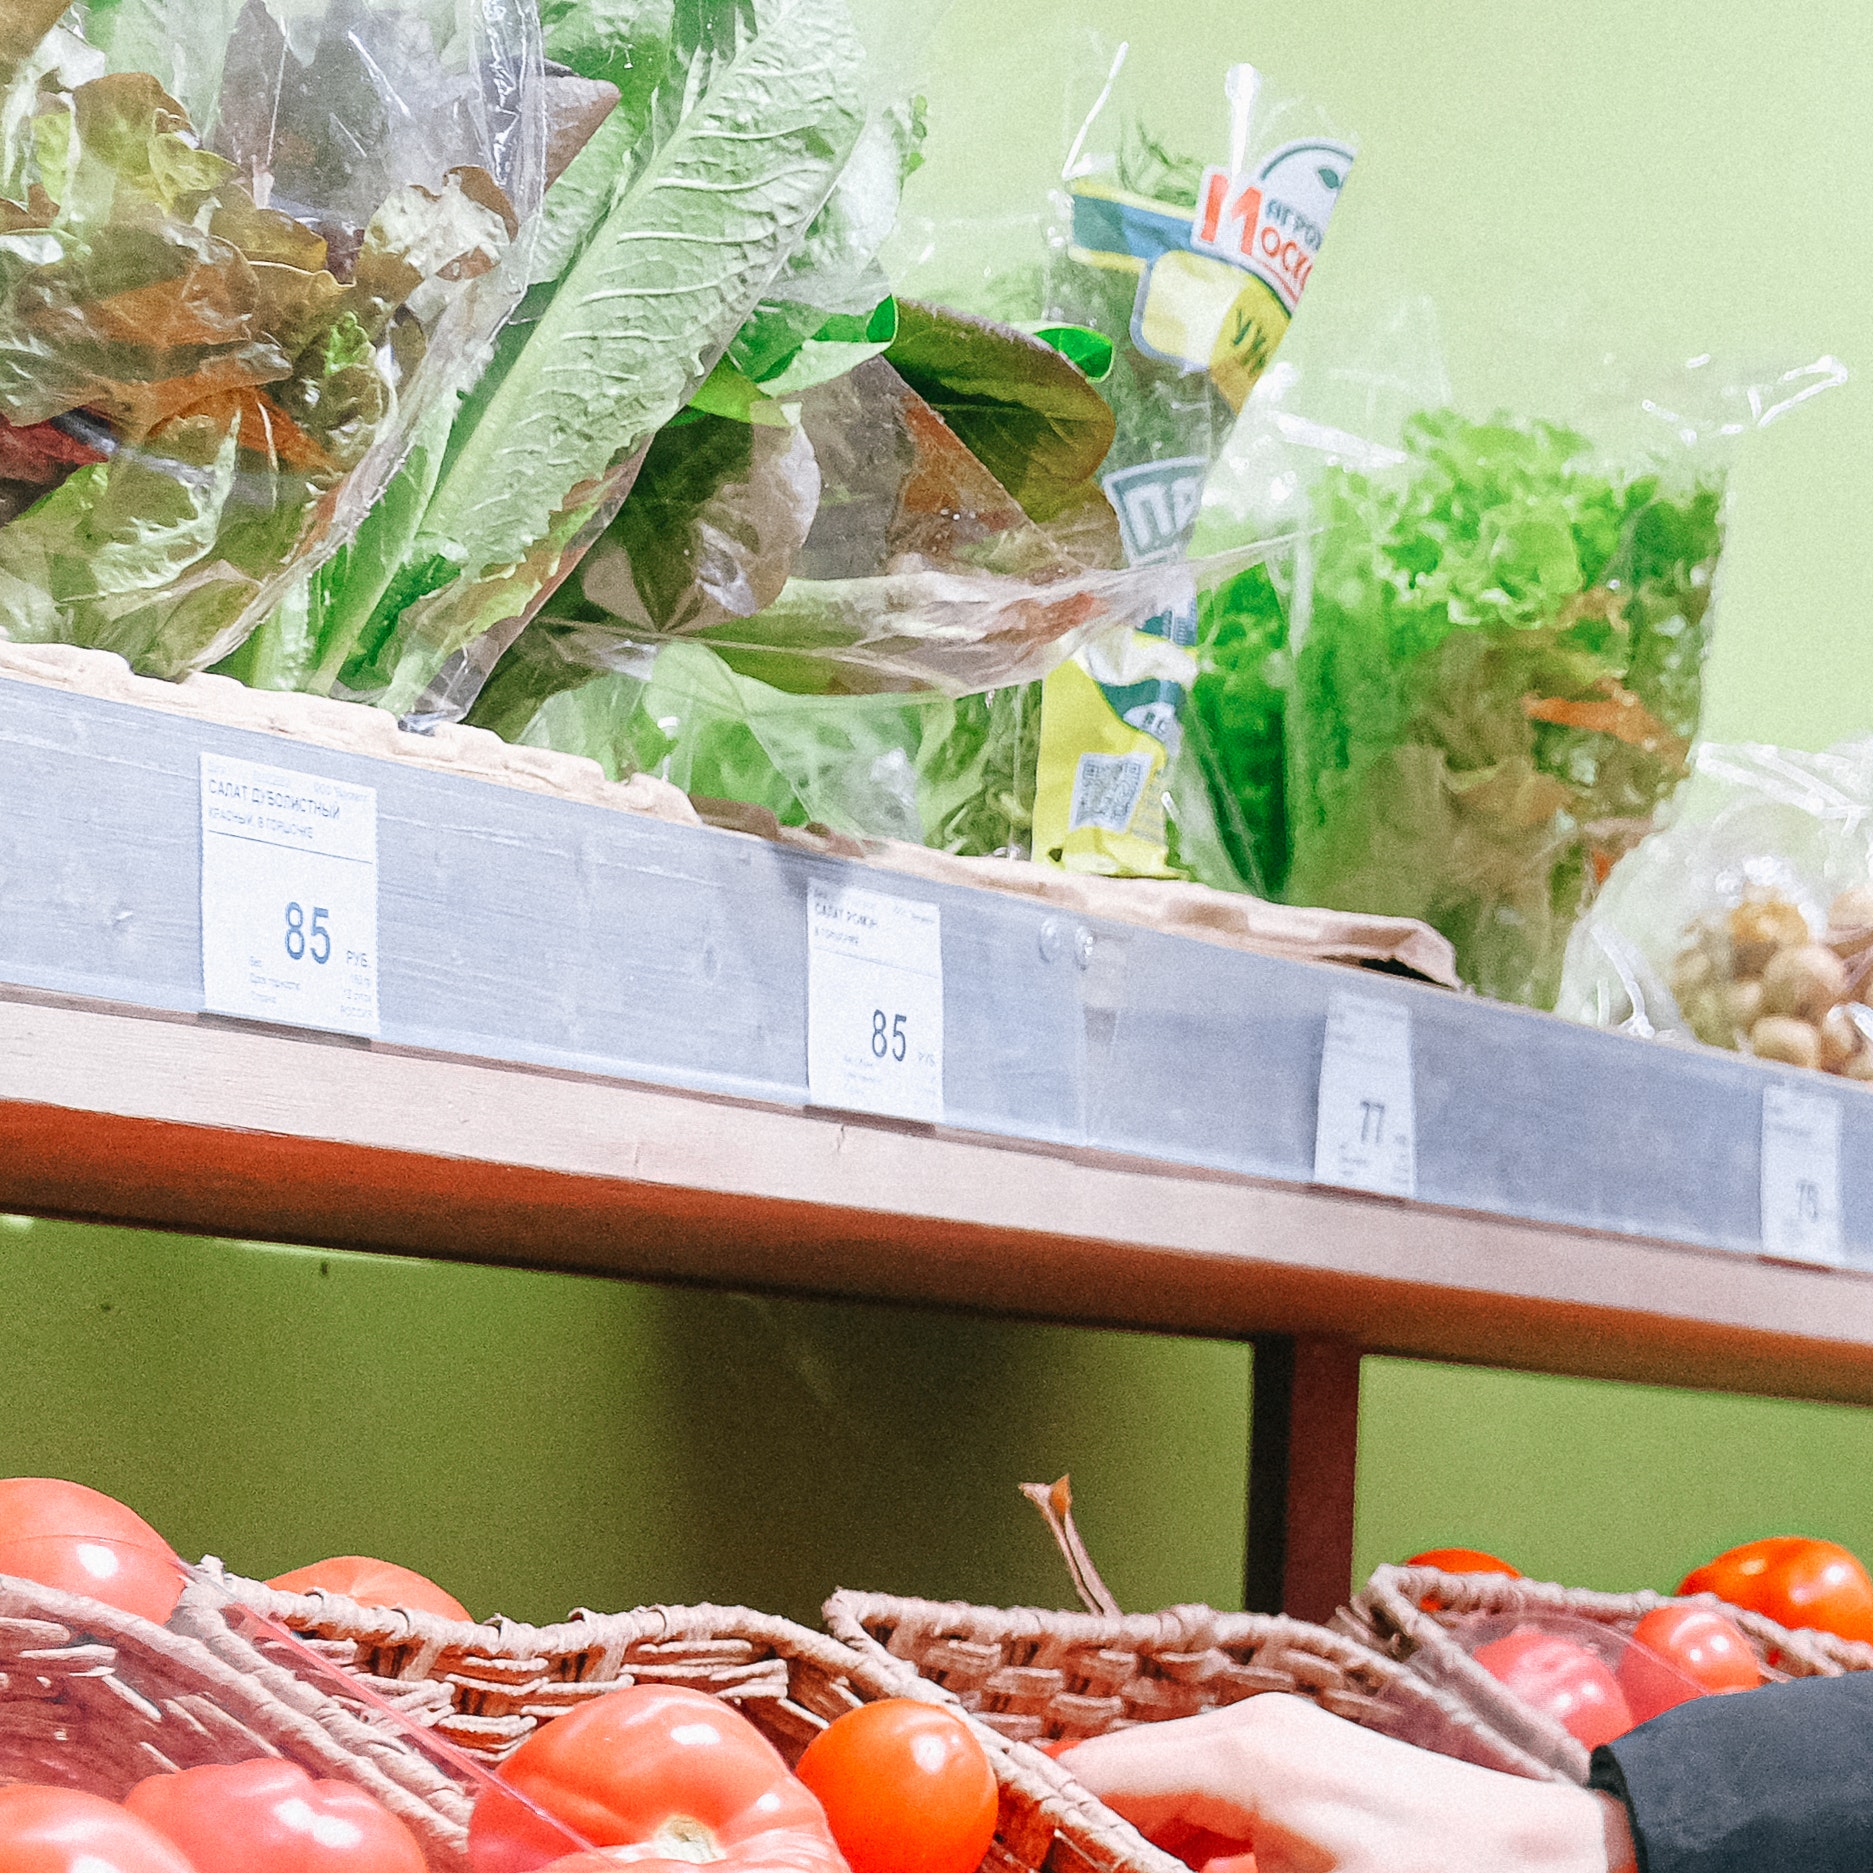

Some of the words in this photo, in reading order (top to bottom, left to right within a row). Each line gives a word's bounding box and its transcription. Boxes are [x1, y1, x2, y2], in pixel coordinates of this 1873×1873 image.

[208, 778, 248, 800] САЛАТ
[285, 901, 331, 965] 85
[871, 1008, 907, 1062] 85
[1361, 1099, 1386, 1144] 77
